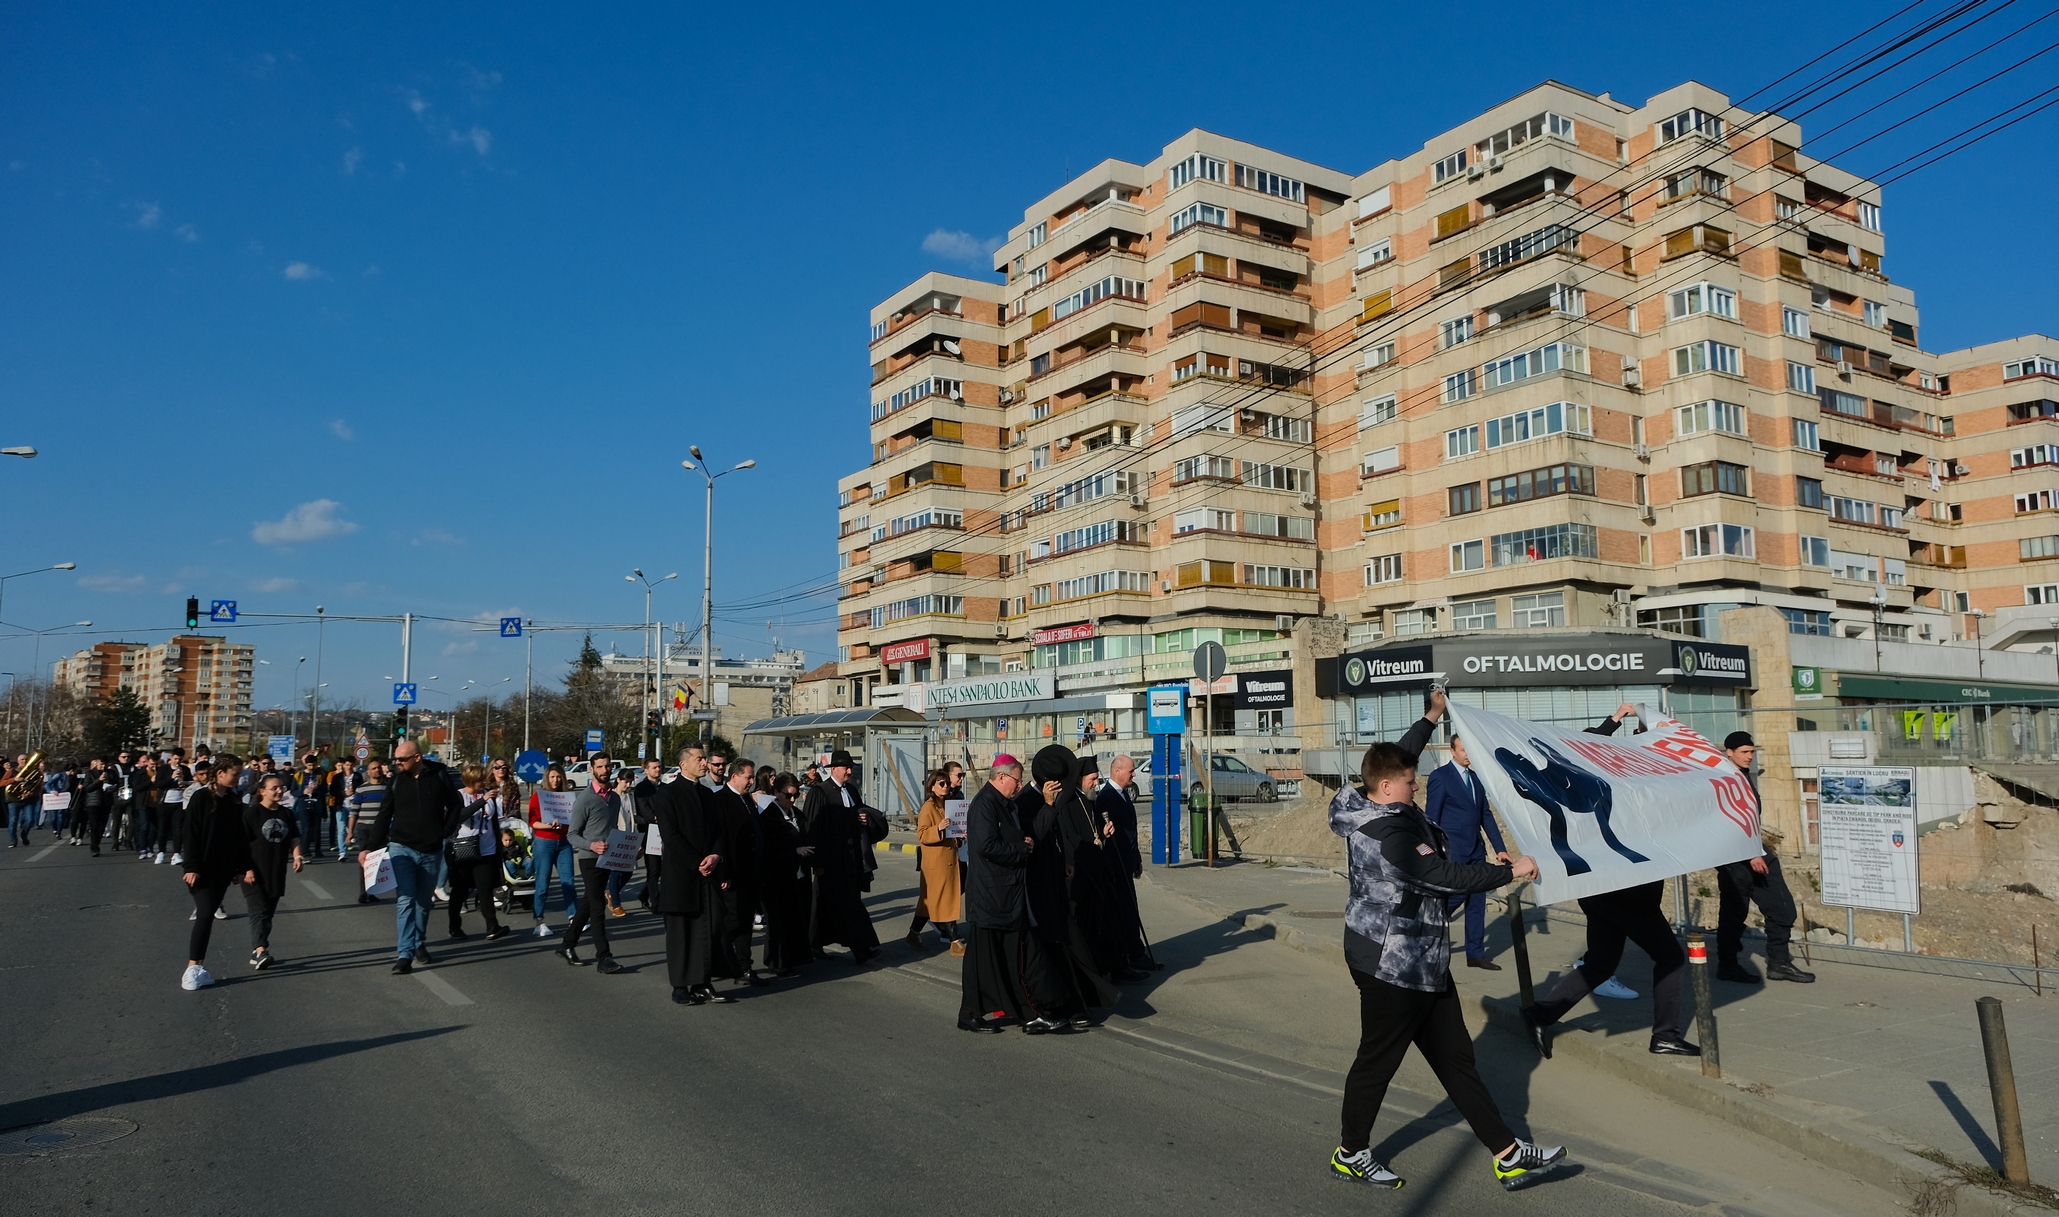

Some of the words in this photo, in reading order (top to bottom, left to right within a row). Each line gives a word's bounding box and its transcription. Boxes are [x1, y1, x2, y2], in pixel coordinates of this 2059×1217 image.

[895, 644, 924, 659] GENERALI
[1367, 659, 1424, 676] Vitreum
[1463, 652, 1644, 674] OFTALMOLOGIE
[1699, 651, 1745, 672] Vitreum
[928, 687, 957, 705] INTESA
[960, 681, 1008, 702] SANPAOLO
[1012, 678, 1041, 698] BANK
[1246, 681, 1285, 692] Vitreum
[1248, 694, 1285, 703] OFTALMOLOGIE
[1962, 689, 1972, 697] CEC
[1978, 690, 1990, 698] Bank
[1000, 719, 1004, 727] P
[1079, 719, 1083, 728] P
